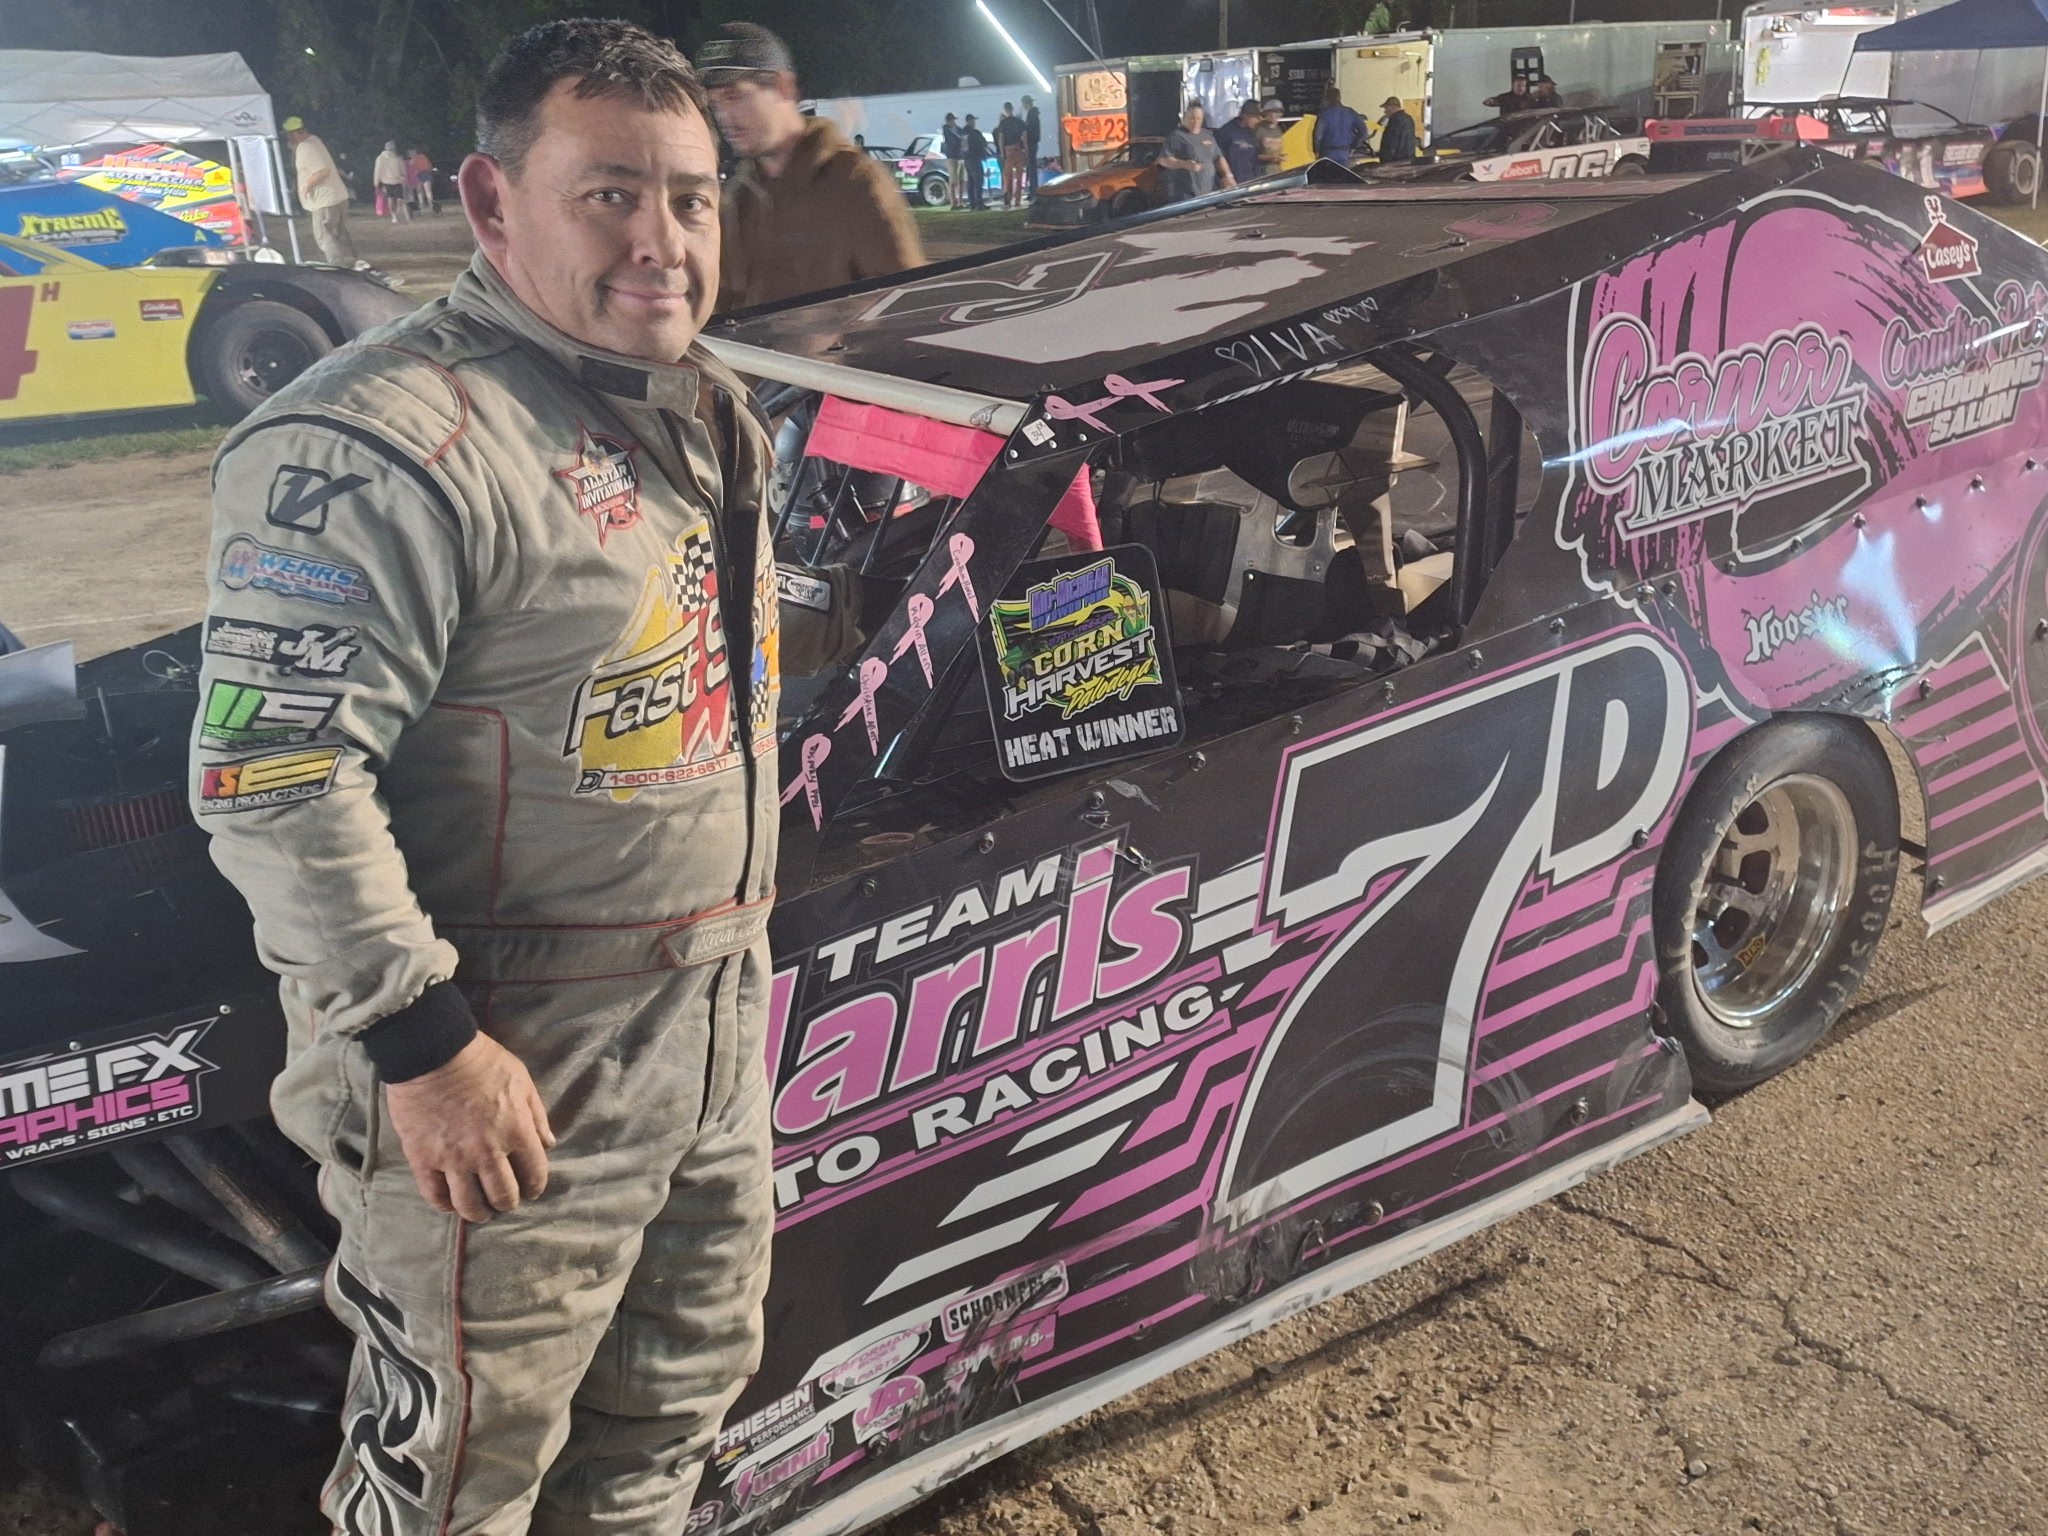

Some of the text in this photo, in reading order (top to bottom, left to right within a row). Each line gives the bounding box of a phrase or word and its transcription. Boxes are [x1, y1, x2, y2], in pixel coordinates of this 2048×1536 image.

[1104, 118, 1127, 142] 23
[20, 207, 126, 238] XTREME
[1926, 239, 1971, 269] Casey's
[41, 281, 61, 302] H
[1883, 306, 1989, 385] Country
[1588, 319, 1849, 484] Corner
[1906, 351, 2043, 421] GROOMING
[1928, 388, 2018, 444] SALON
[1626, 396, 1866, 526] MARKET
[580, 475, 635, 510] INVITATIONAL
[1032, 618, 1125, 677] CORN
[1743, 591, 1849, 664] Hoosier
[1006, 630, 1152, 715] HARVEST
[1004, 706, 1178, 768] HEAT WINNER
[817, 853, 1062, 982] TEAM
[911, 984, 1214, 1150] RACING
[5, 1104, 194, 1160] WRAPS SIGNS ETC
[713, 1383, 812, 1456] FRIESEN
[751, 1402, 816, 1447] PERFORMANCE
